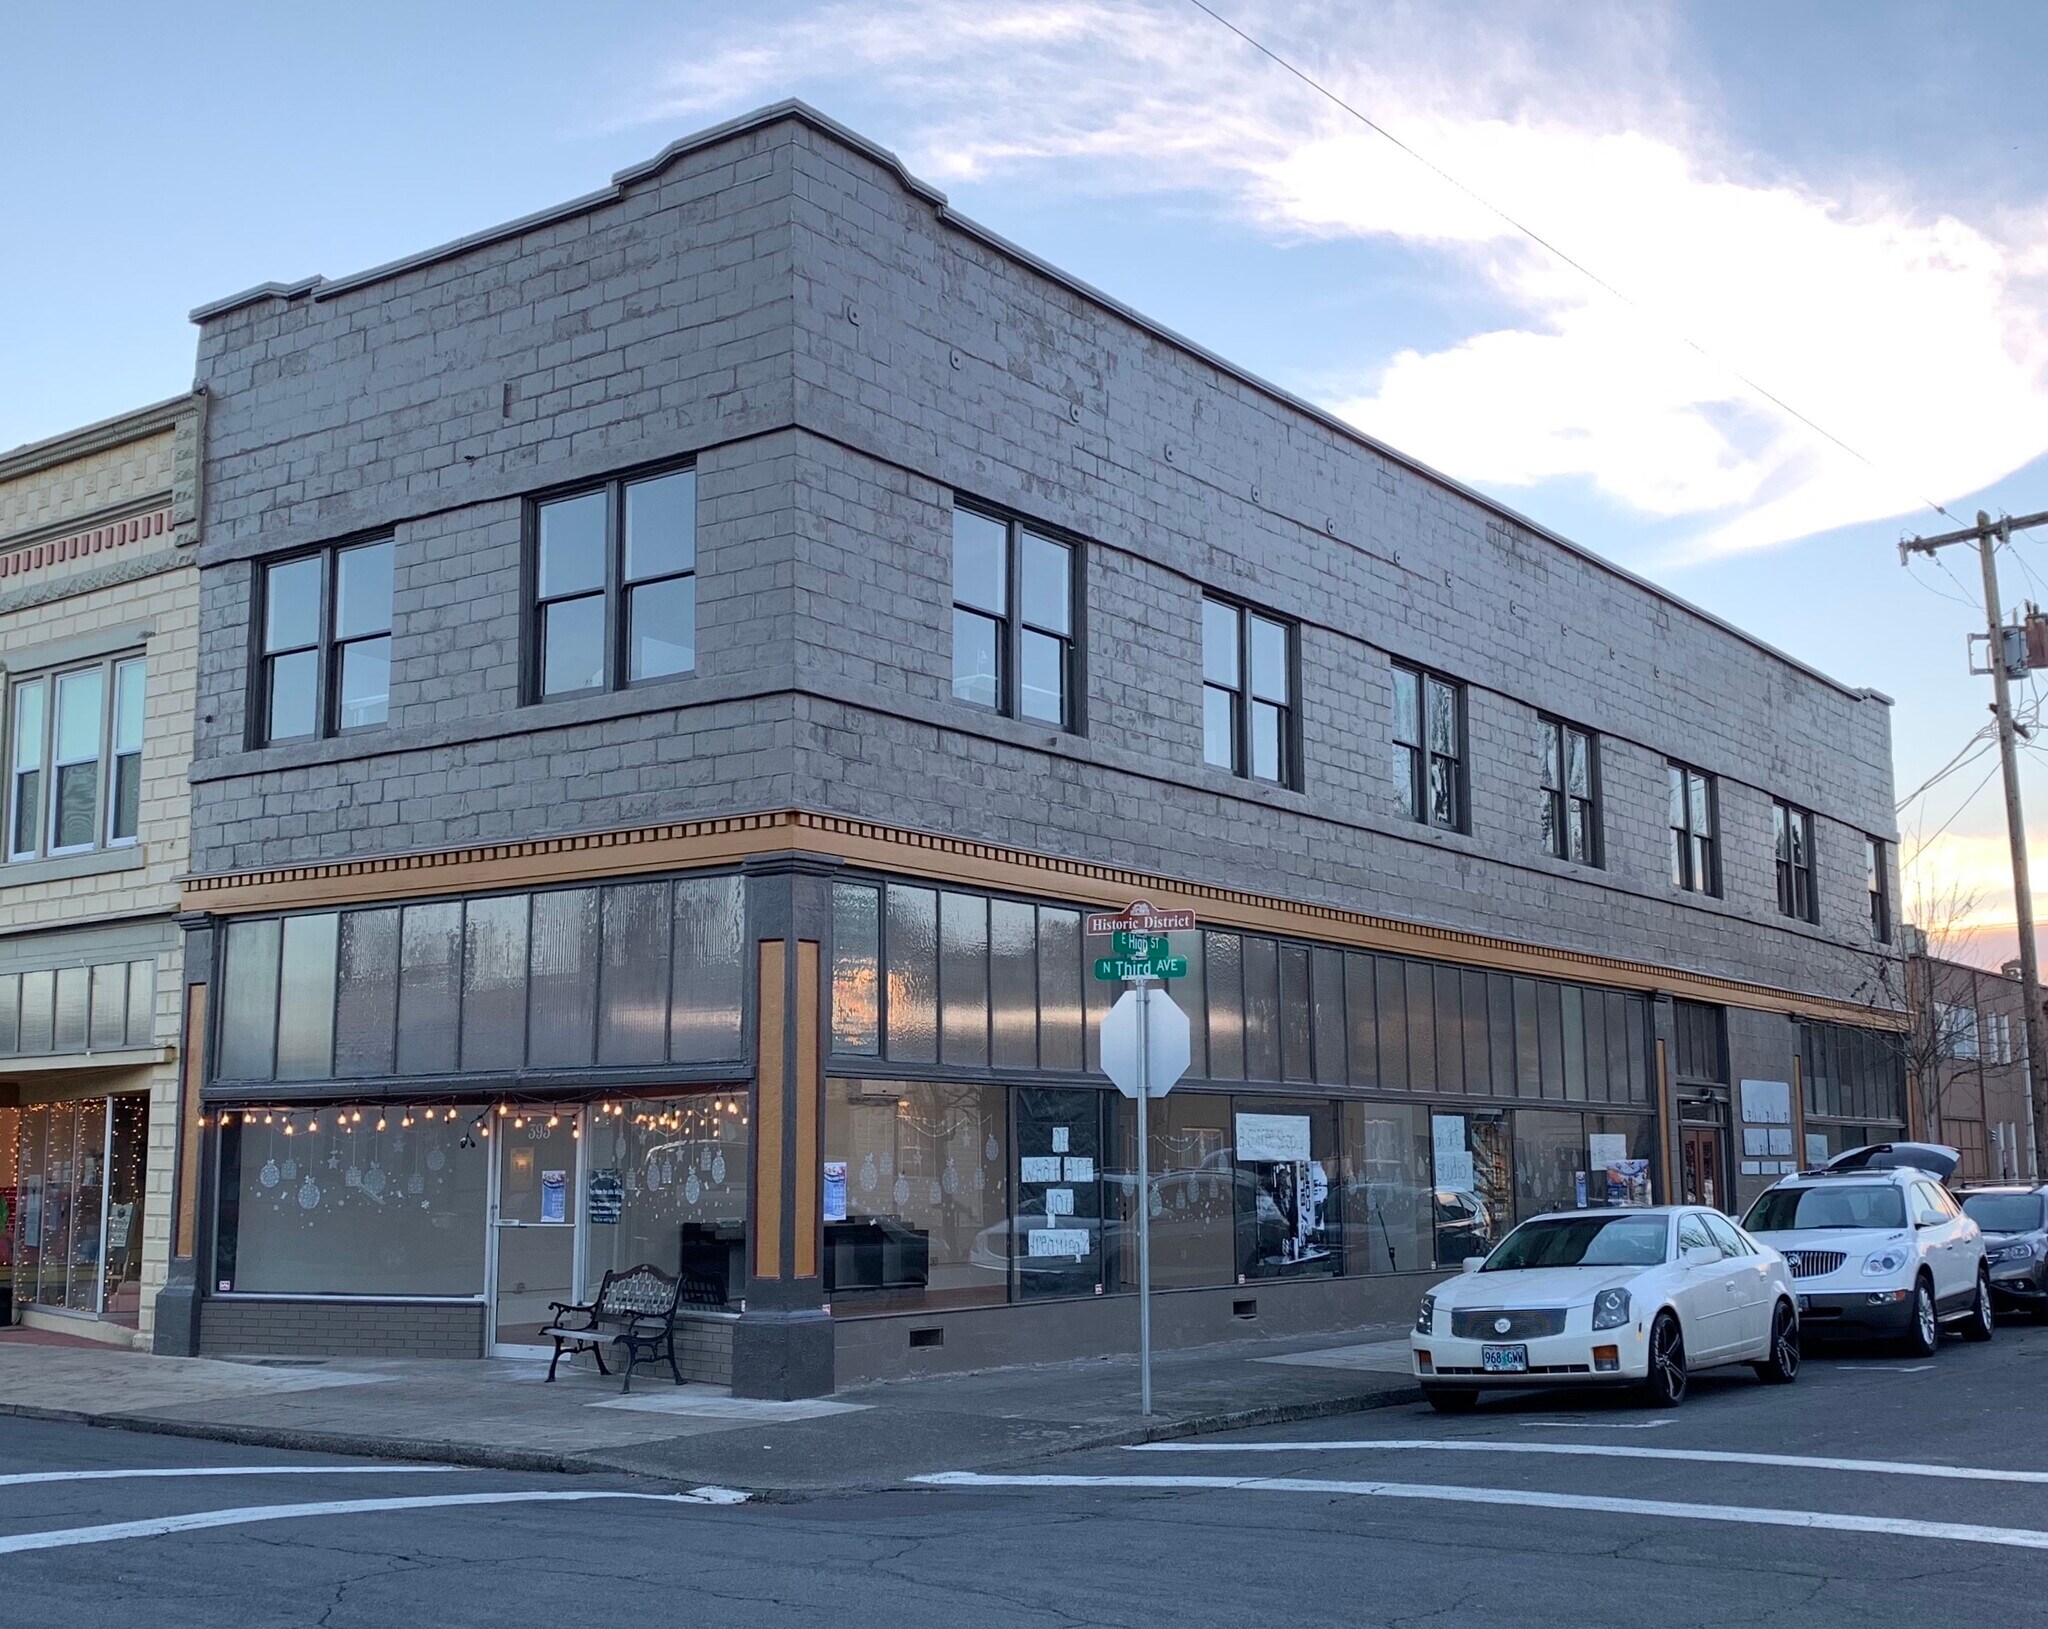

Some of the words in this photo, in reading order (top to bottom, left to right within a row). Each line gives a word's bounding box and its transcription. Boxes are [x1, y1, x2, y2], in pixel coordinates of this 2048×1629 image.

[1092, 917, 1139, 931] Historic
[1144, 915, 1190, 929] District
[1121, 933, 1126, 945] E
[1150, 937, 1159, 949] ST
[1103, 962, 1111, 974] N
[1116, 960, 1151, 976] Third
[1156, 959, 1178, 972] AVE
[1485, 1351, 1502, 1364] 968
